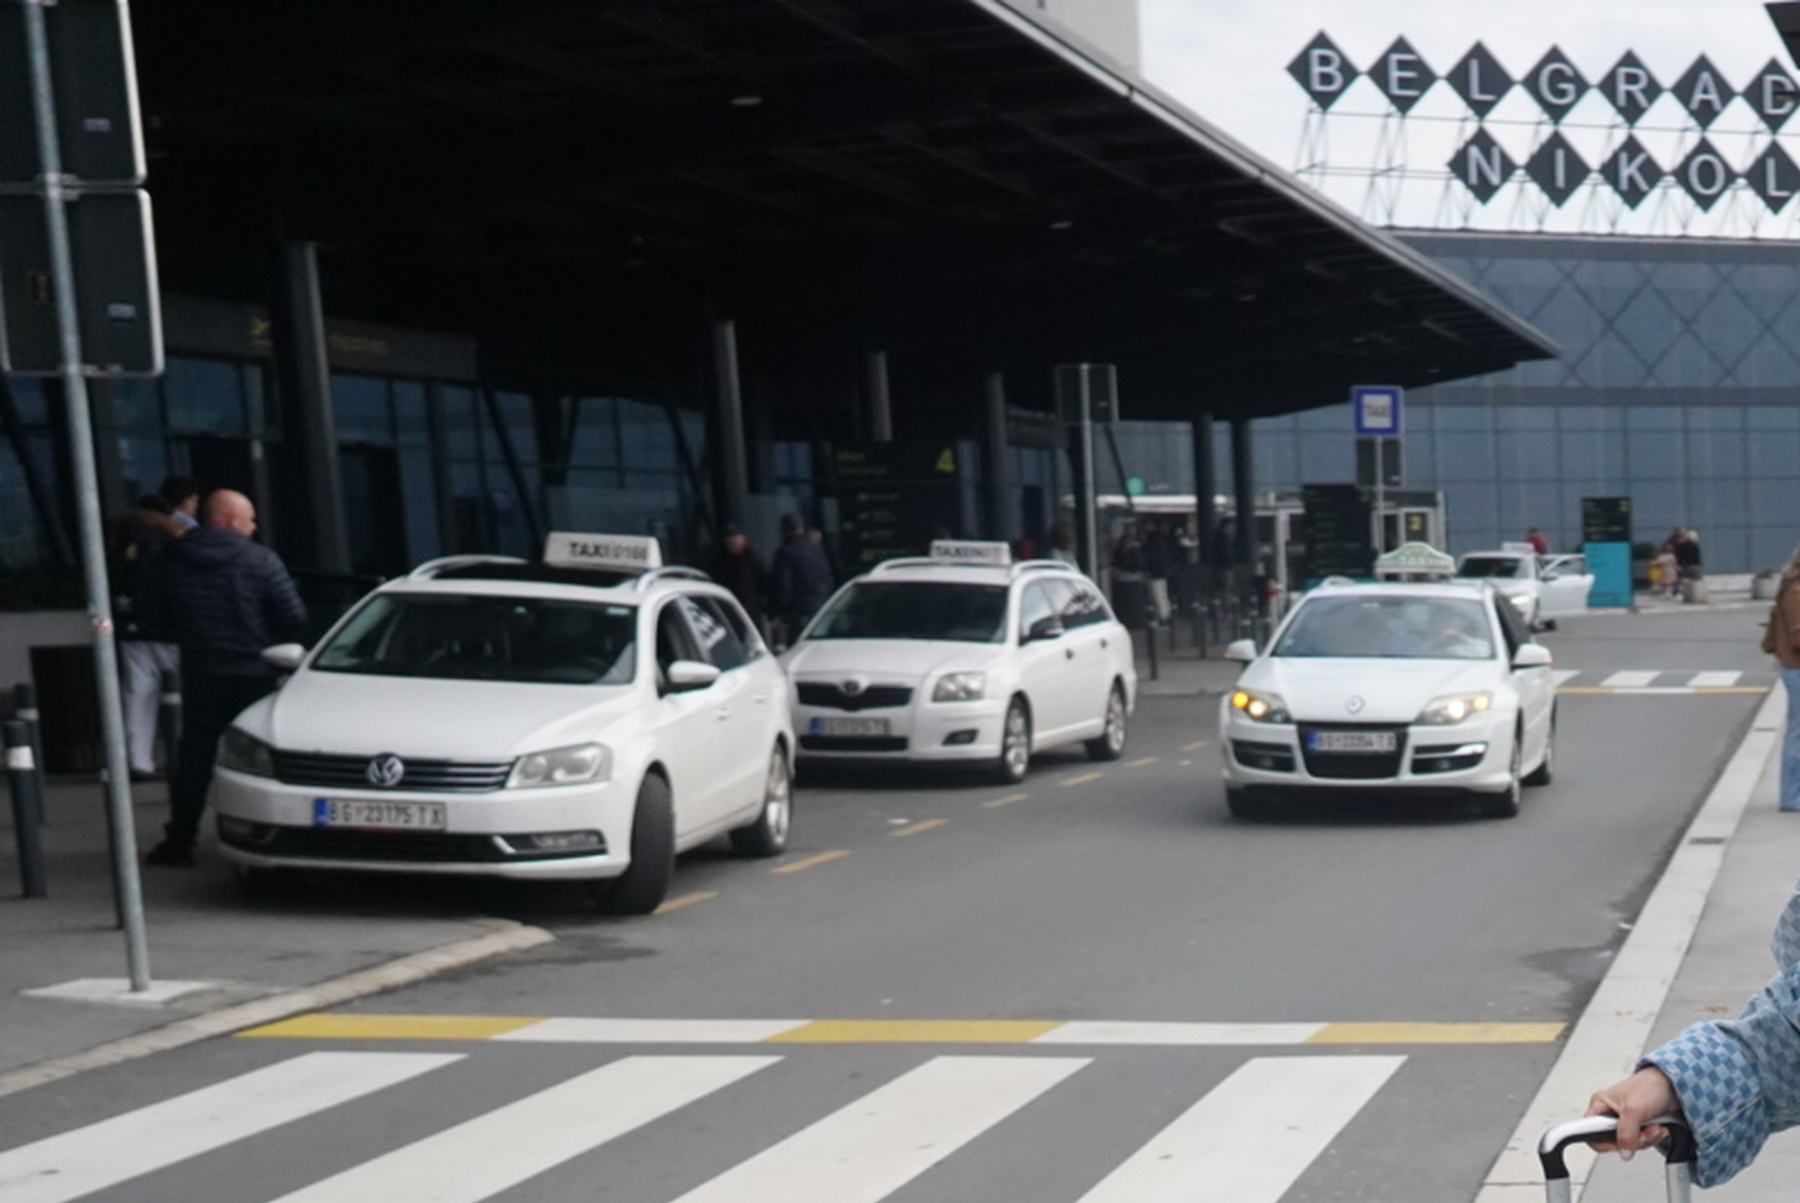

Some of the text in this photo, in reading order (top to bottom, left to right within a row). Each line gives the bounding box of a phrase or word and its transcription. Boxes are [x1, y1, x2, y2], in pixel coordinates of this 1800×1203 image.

[1309, 47, 1795, 116] BELGRAD
[1466, 145, 1791, 199] NIKOL
[569, 541, 611, 560] TAXI
[329, 801, 353, 823] BG
